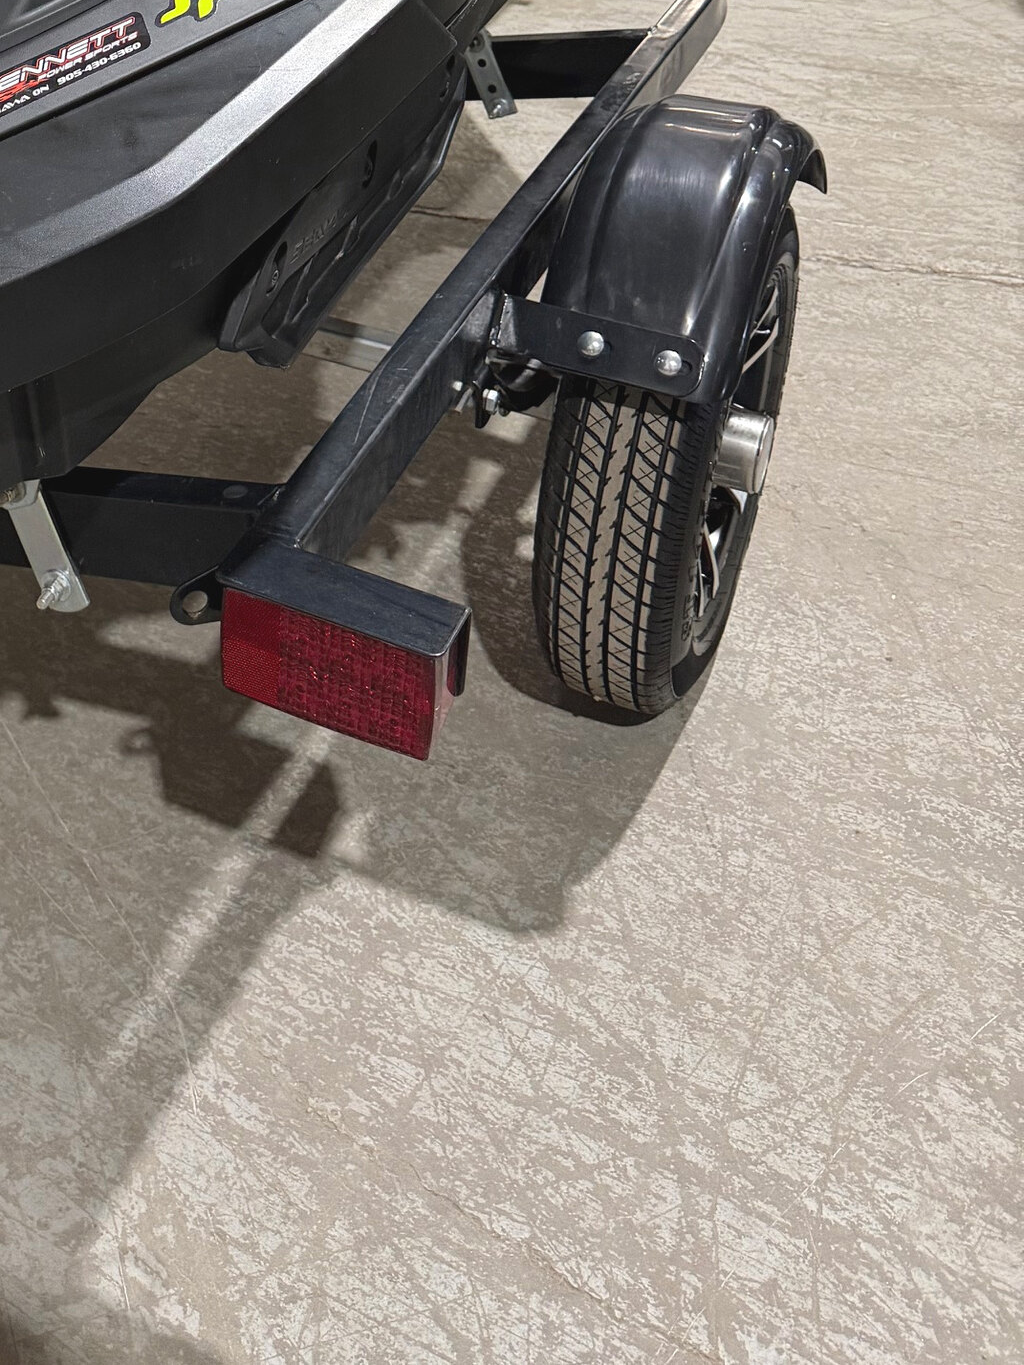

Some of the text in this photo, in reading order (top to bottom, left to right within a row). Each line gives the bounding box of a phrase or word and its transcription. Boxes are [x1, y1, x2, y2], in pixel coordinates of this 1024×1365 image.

[37, 31, 139, 82] POWER SPORTS
[32, 85, 50, 97] ON
